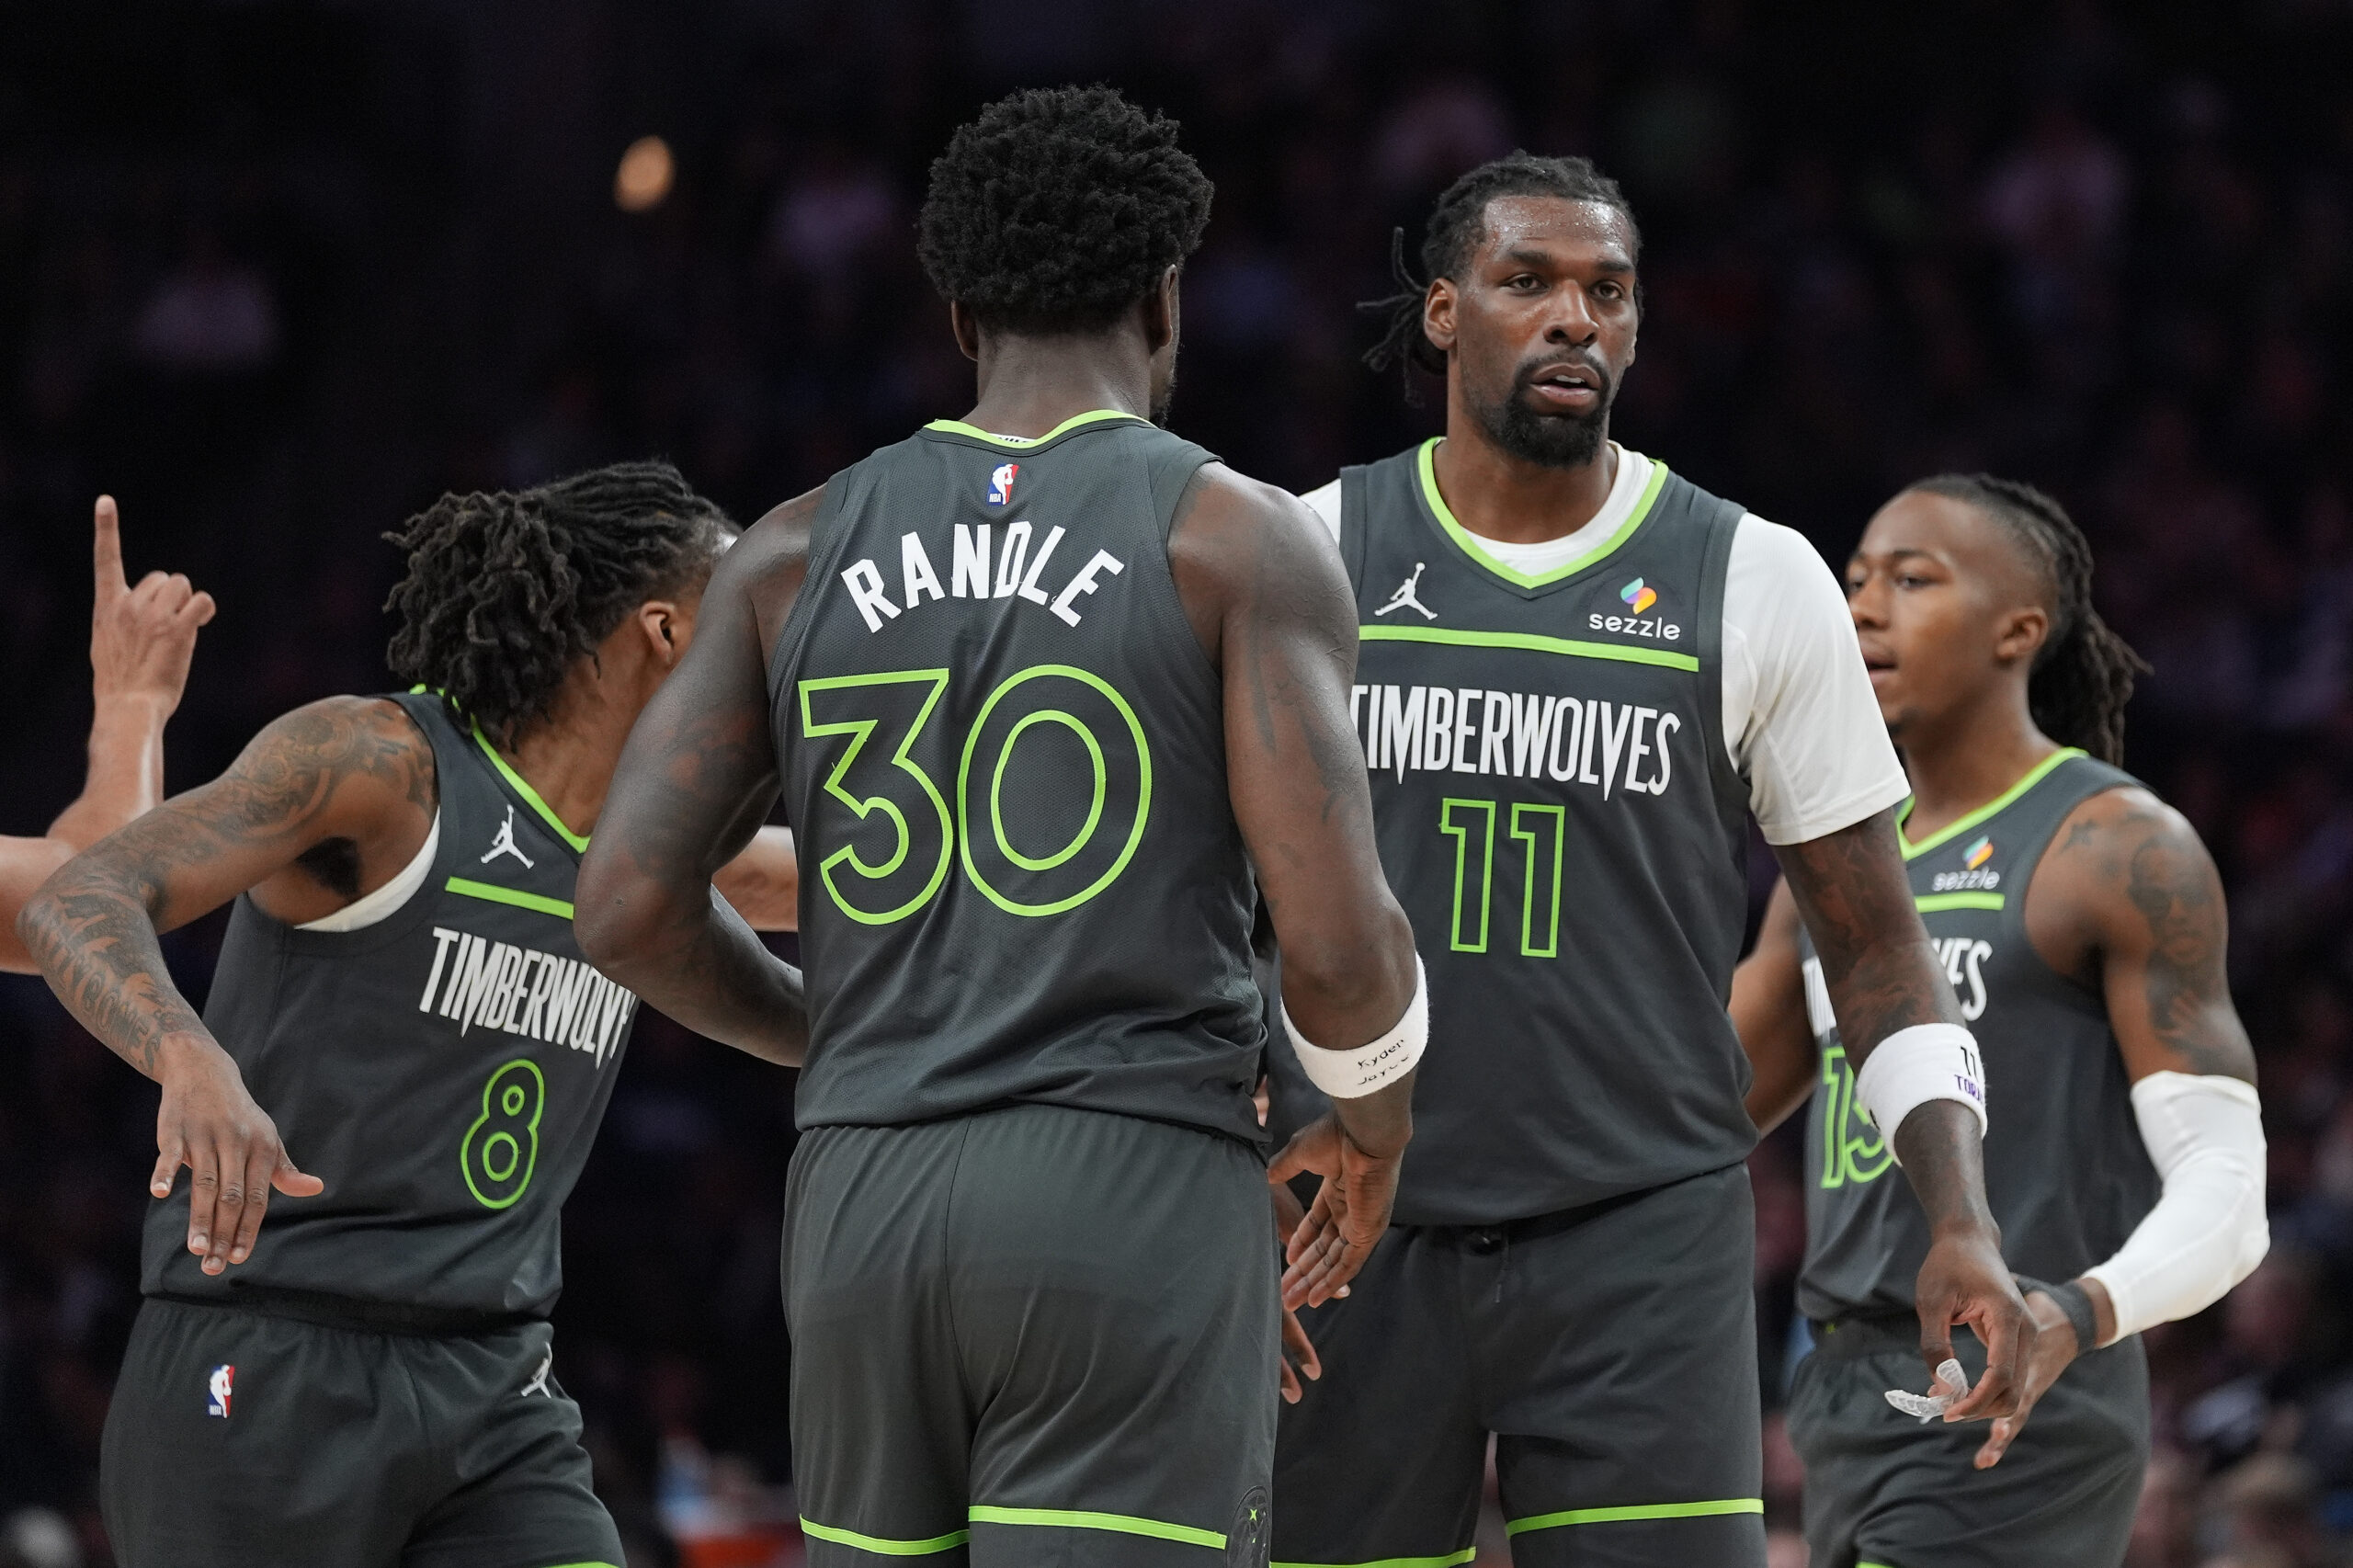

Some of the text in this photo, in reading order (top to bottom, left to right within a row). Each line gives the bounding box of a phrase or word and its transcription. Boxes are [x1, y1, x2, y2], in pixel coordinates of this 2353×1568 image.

[989, 493, 1001, 503] NBA
[840, 520, 1125, 633] RANDLE
[1588, 613, 1681, 641] sezzle
[798, 665, 1153, 926] 30
[1349, 684, 1681, 801] TIMBERWOLVES
[1438, 797, 1565, 959] 11
[1932, 865, 2000, 892] sezzle
[460, 1058, 545, 1210] 8
